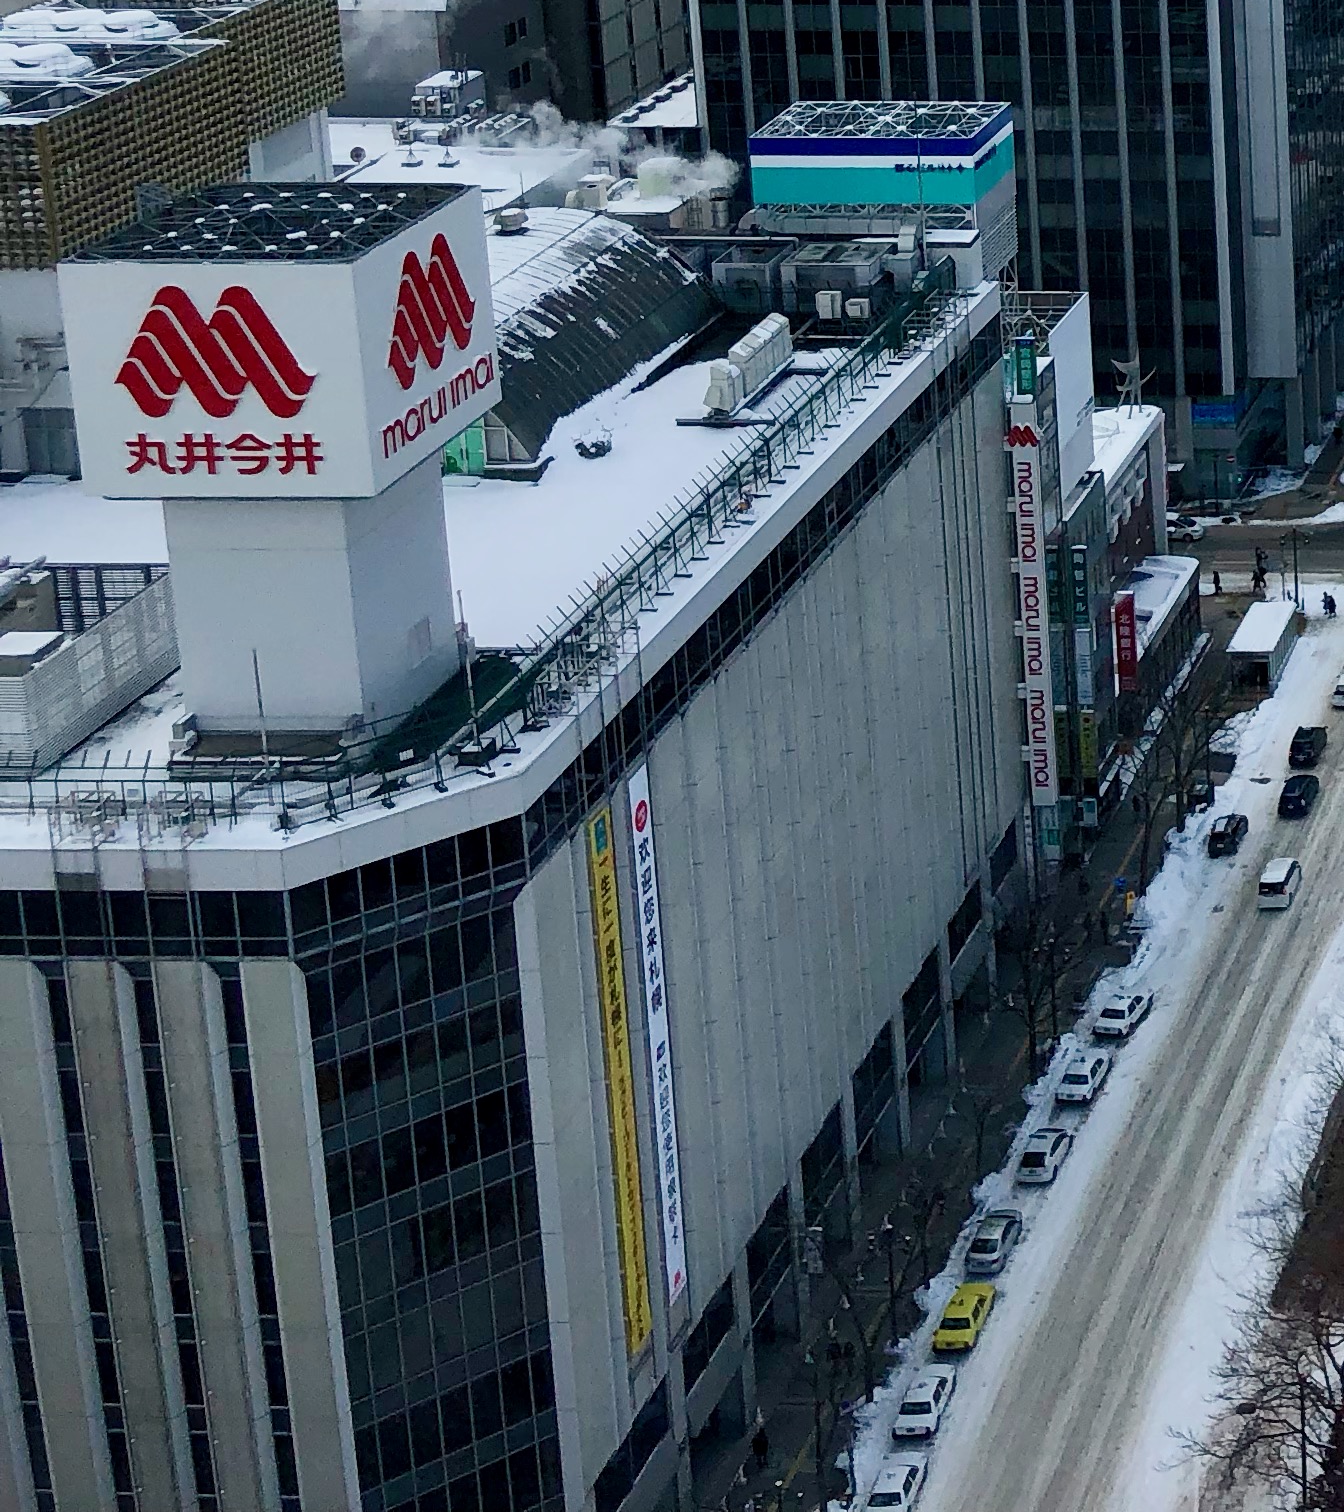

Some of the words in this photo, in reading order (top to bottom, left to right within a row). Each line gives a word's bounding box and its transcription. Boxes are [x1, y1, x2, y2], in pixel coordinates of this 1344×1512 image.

[383, 387, 447, 459] marui
[450, 353, 495, 409] imai
[126, 433, 323, 476] 丸井今井
[1017, 461, 1034, 518] marui
[1020, 521, 1037, 563] imai
[1023, 576, 1039, 632] marui
[1027, 637, 1042, 676] imai
[1119, 613, 1132, 661] 北陸銀行
[1029, 689, 1046, 745] marui
[1032, 749, 1049, 788] imai
